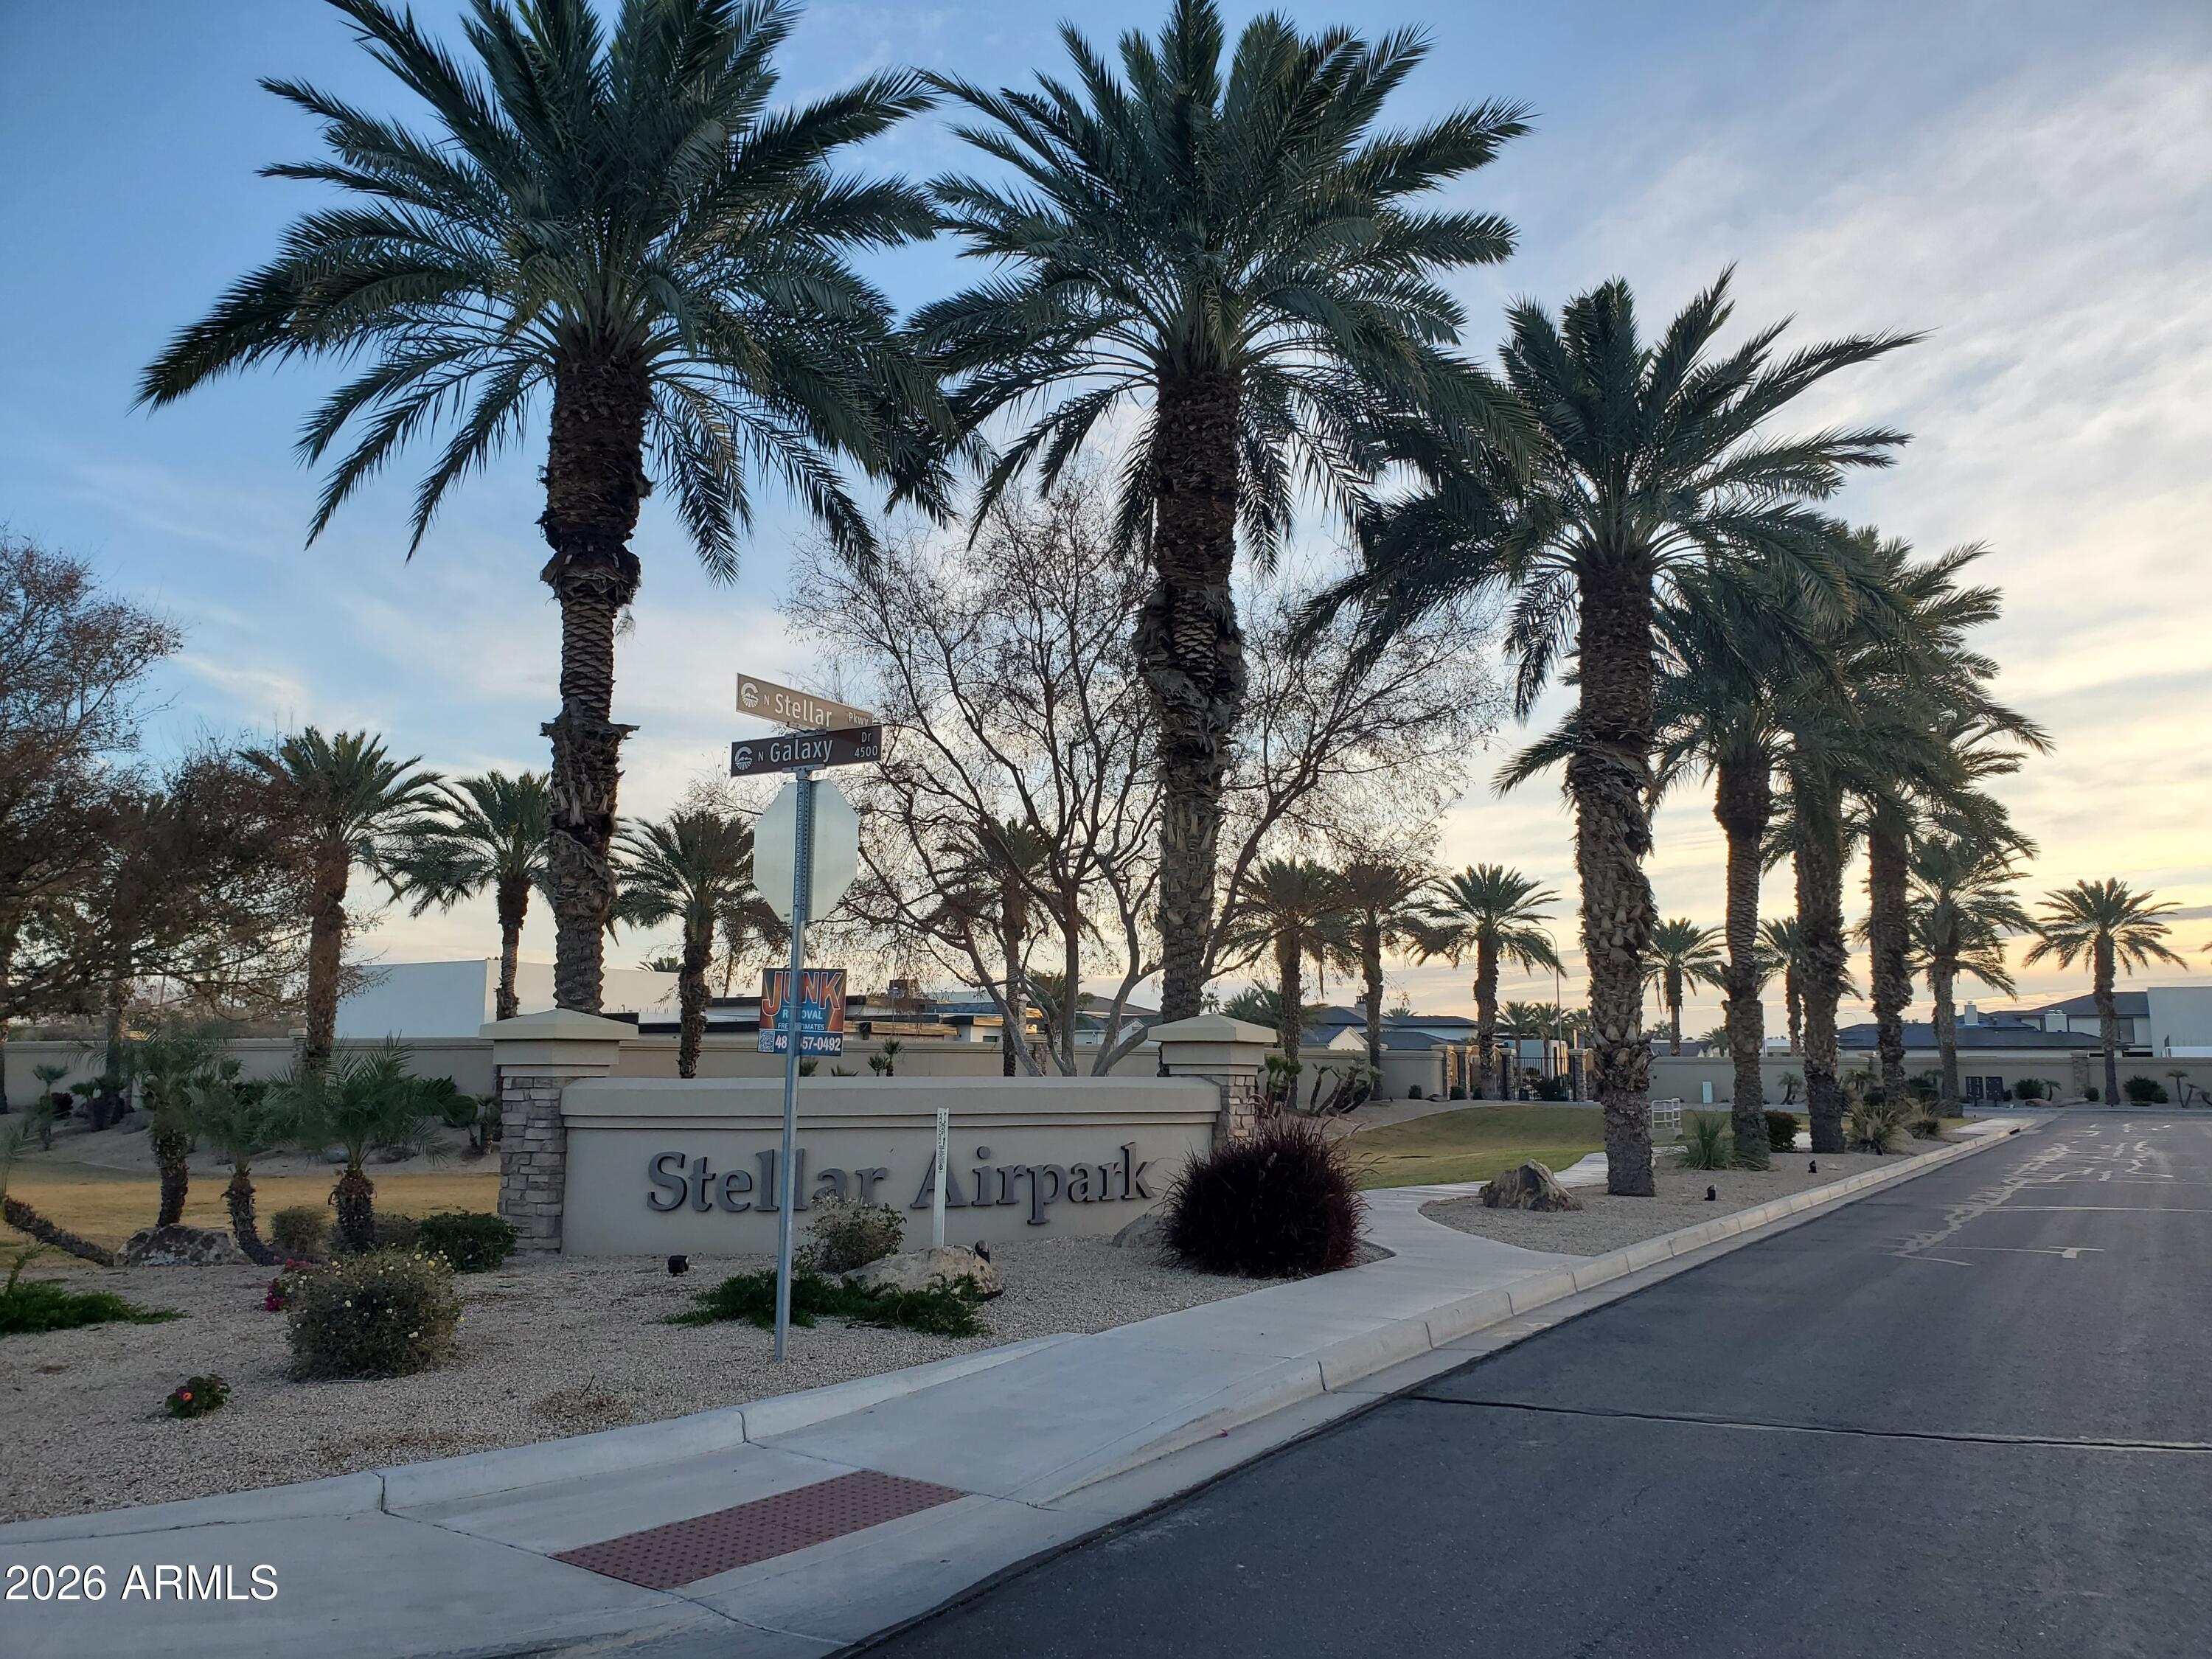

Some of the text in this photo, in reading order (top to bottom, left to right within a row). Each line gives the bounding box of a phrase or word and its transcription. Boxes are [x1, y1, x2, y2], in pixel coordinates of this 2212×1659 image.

[764, 693, 869, 727] N Stellar Pkwy
[861, 731, 872, 742] Dr
[758, 739, 878, 762] N Galaxy 4500
[782, 1009, 823, 1020] ROVAL
[775, 1034, 841, 1051] 4857-0492
[647, 1147, 888, 1213] Stellar
[911, 1141, 1155, 1225] Airpark
